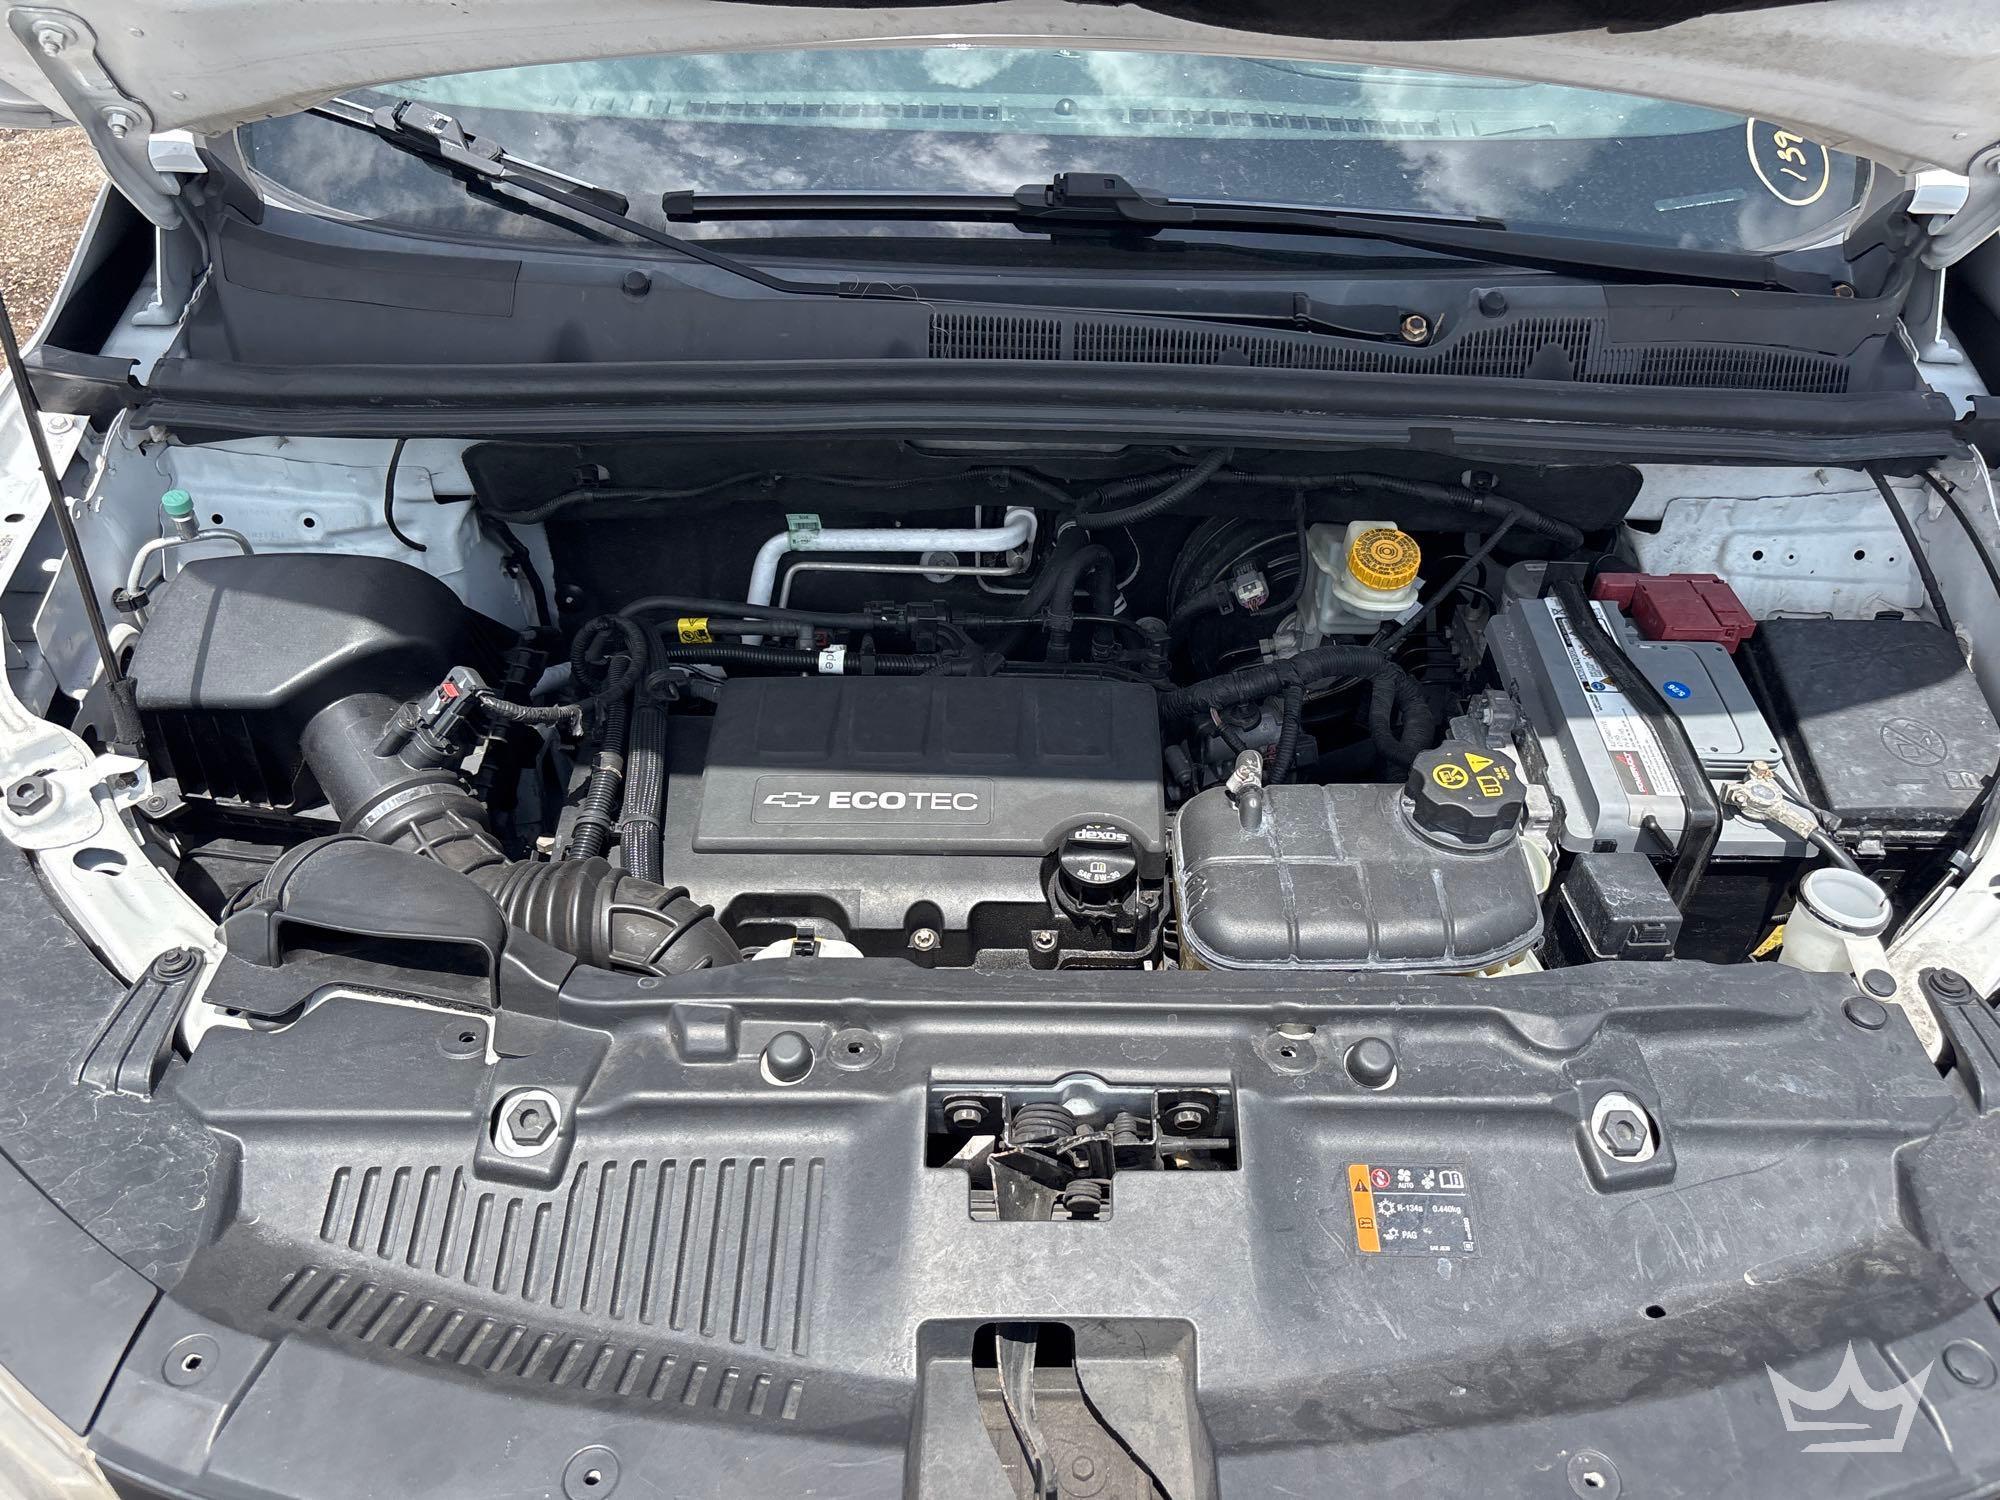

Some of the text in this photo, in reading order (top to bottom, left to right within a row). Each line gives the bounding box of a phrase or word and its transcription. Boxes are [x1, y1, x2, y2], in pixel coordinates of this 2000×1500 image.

[1774, 130, 1807, 181] 139
[828, 791, 978, 811] ECOTEC
[1074, 828, 1129, 841] dexos
[1077, 869, 1121, 881] SAE 5W-30
[1397, 1203, 1461, 1214] R-134a 0.440kg
[1401, 1230, 1418, 1240] PAG
